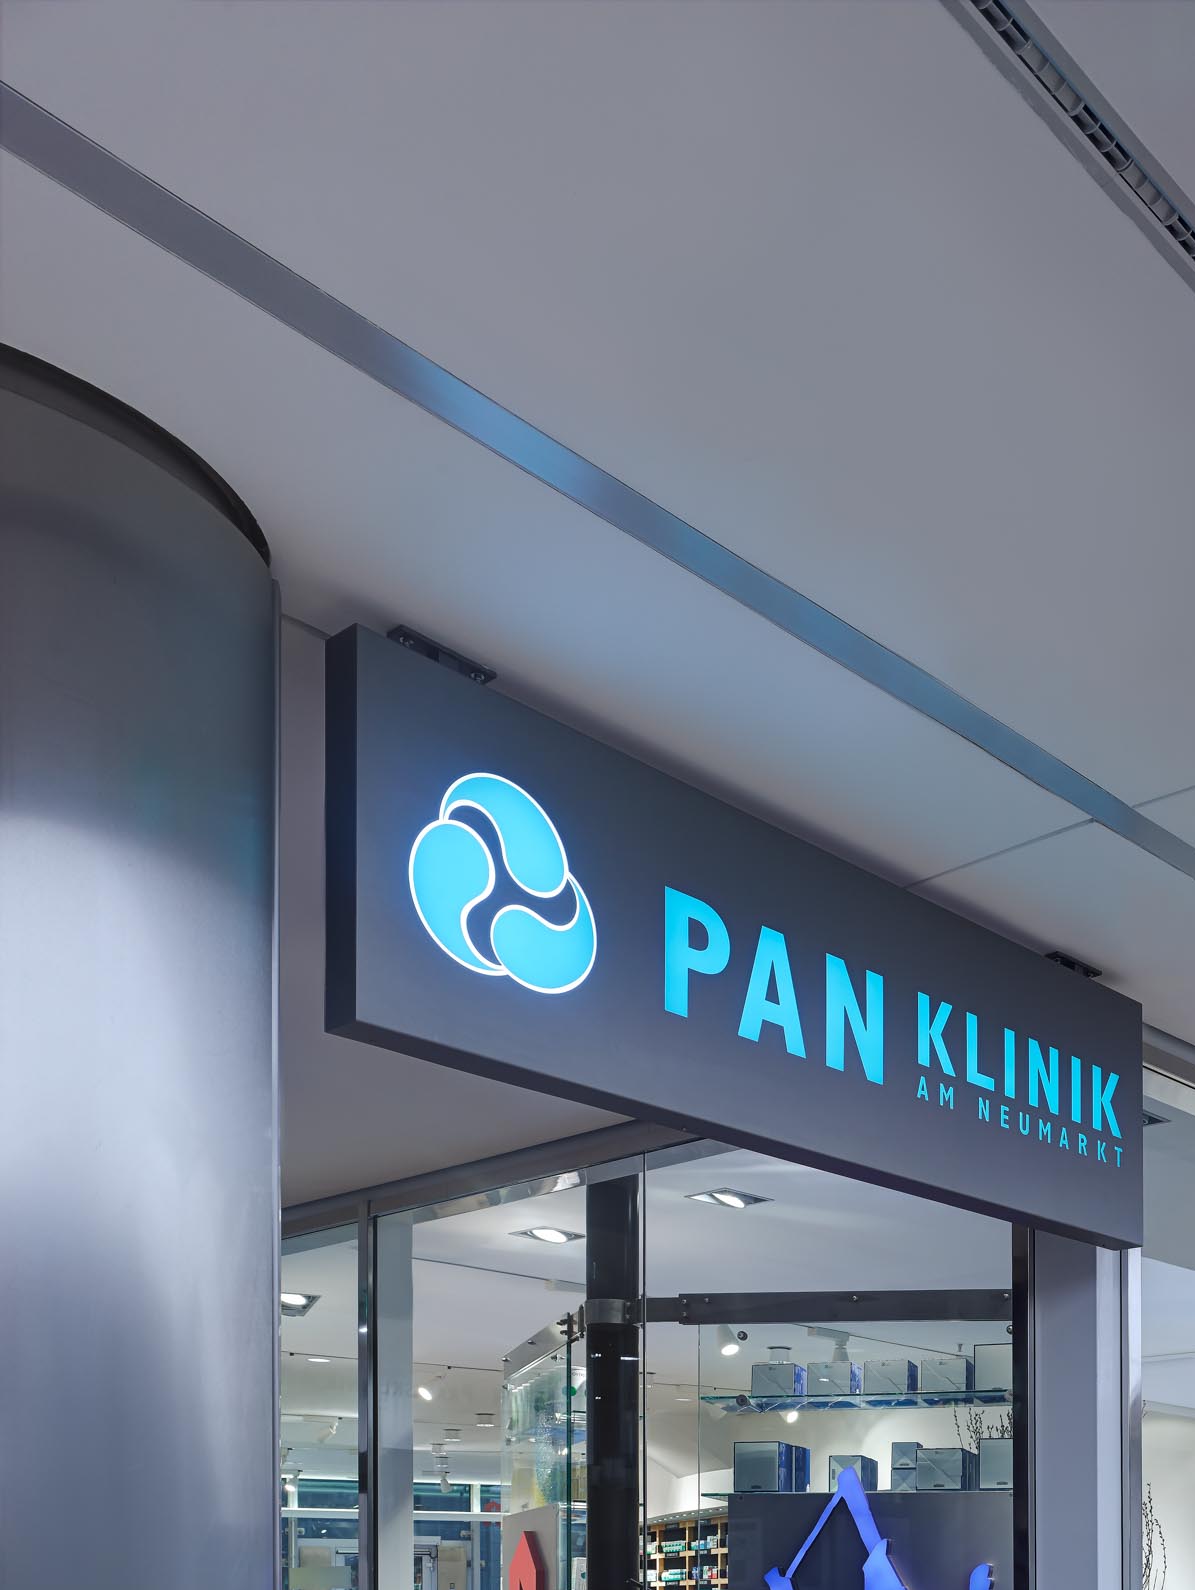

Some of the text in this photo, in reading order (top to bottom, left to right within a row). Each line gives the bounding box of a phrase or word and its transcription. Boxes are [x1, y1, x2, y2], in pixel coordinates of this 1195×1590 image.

[664, 885, 1123, 1140] PAN KLINIK
[916, 1075, 1124, 1168] AM NEUMARKT
